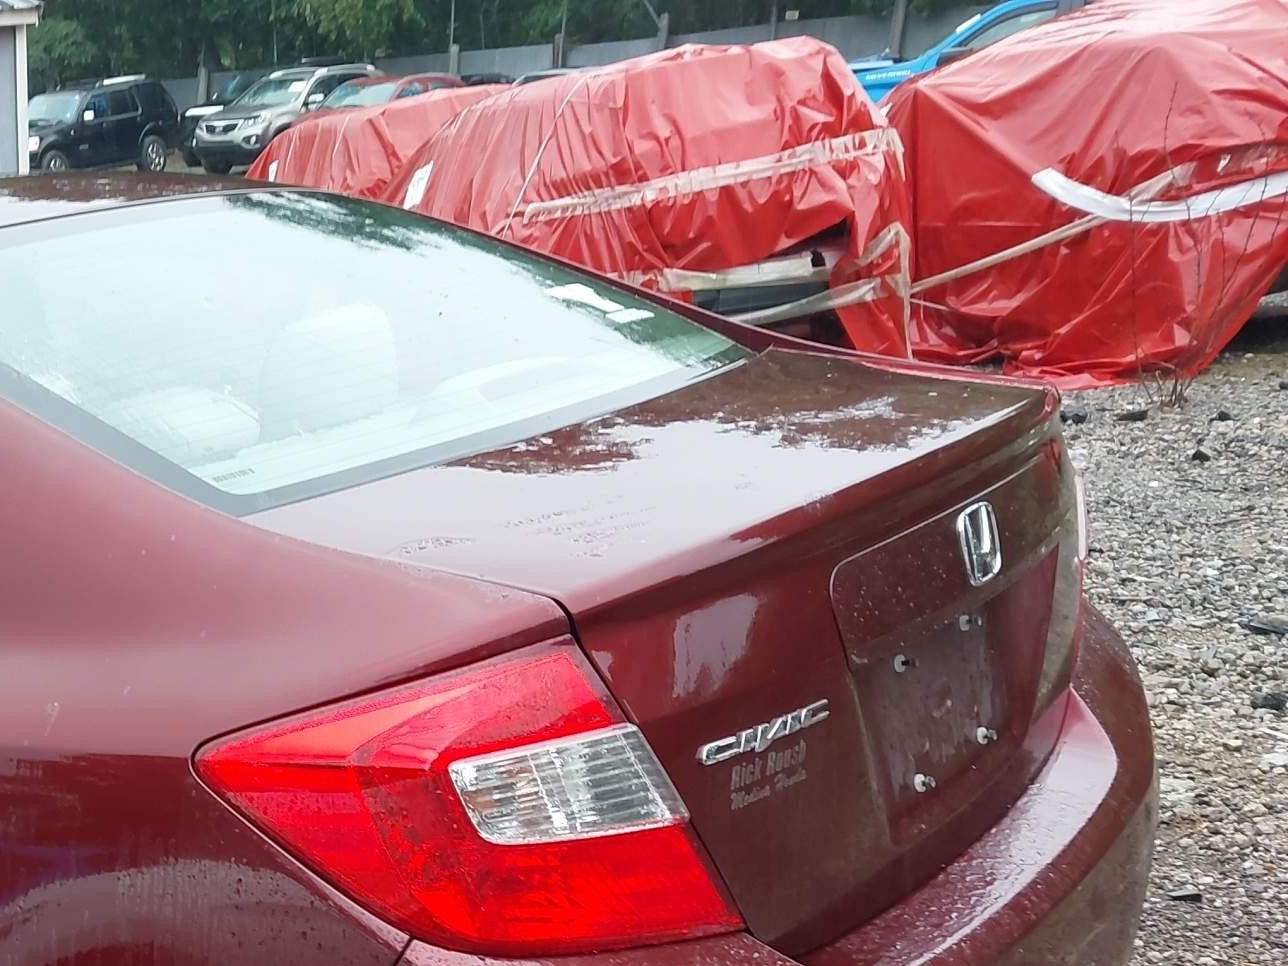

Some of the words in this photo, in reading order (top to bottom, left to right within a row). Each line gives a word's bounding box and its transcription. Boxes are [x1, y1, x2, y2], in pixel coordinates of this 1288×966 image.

[696, 698, 831, 766] CIVIC
[730, 757, 762, 790] Rick
[766, 739, 807, 776] Roush
